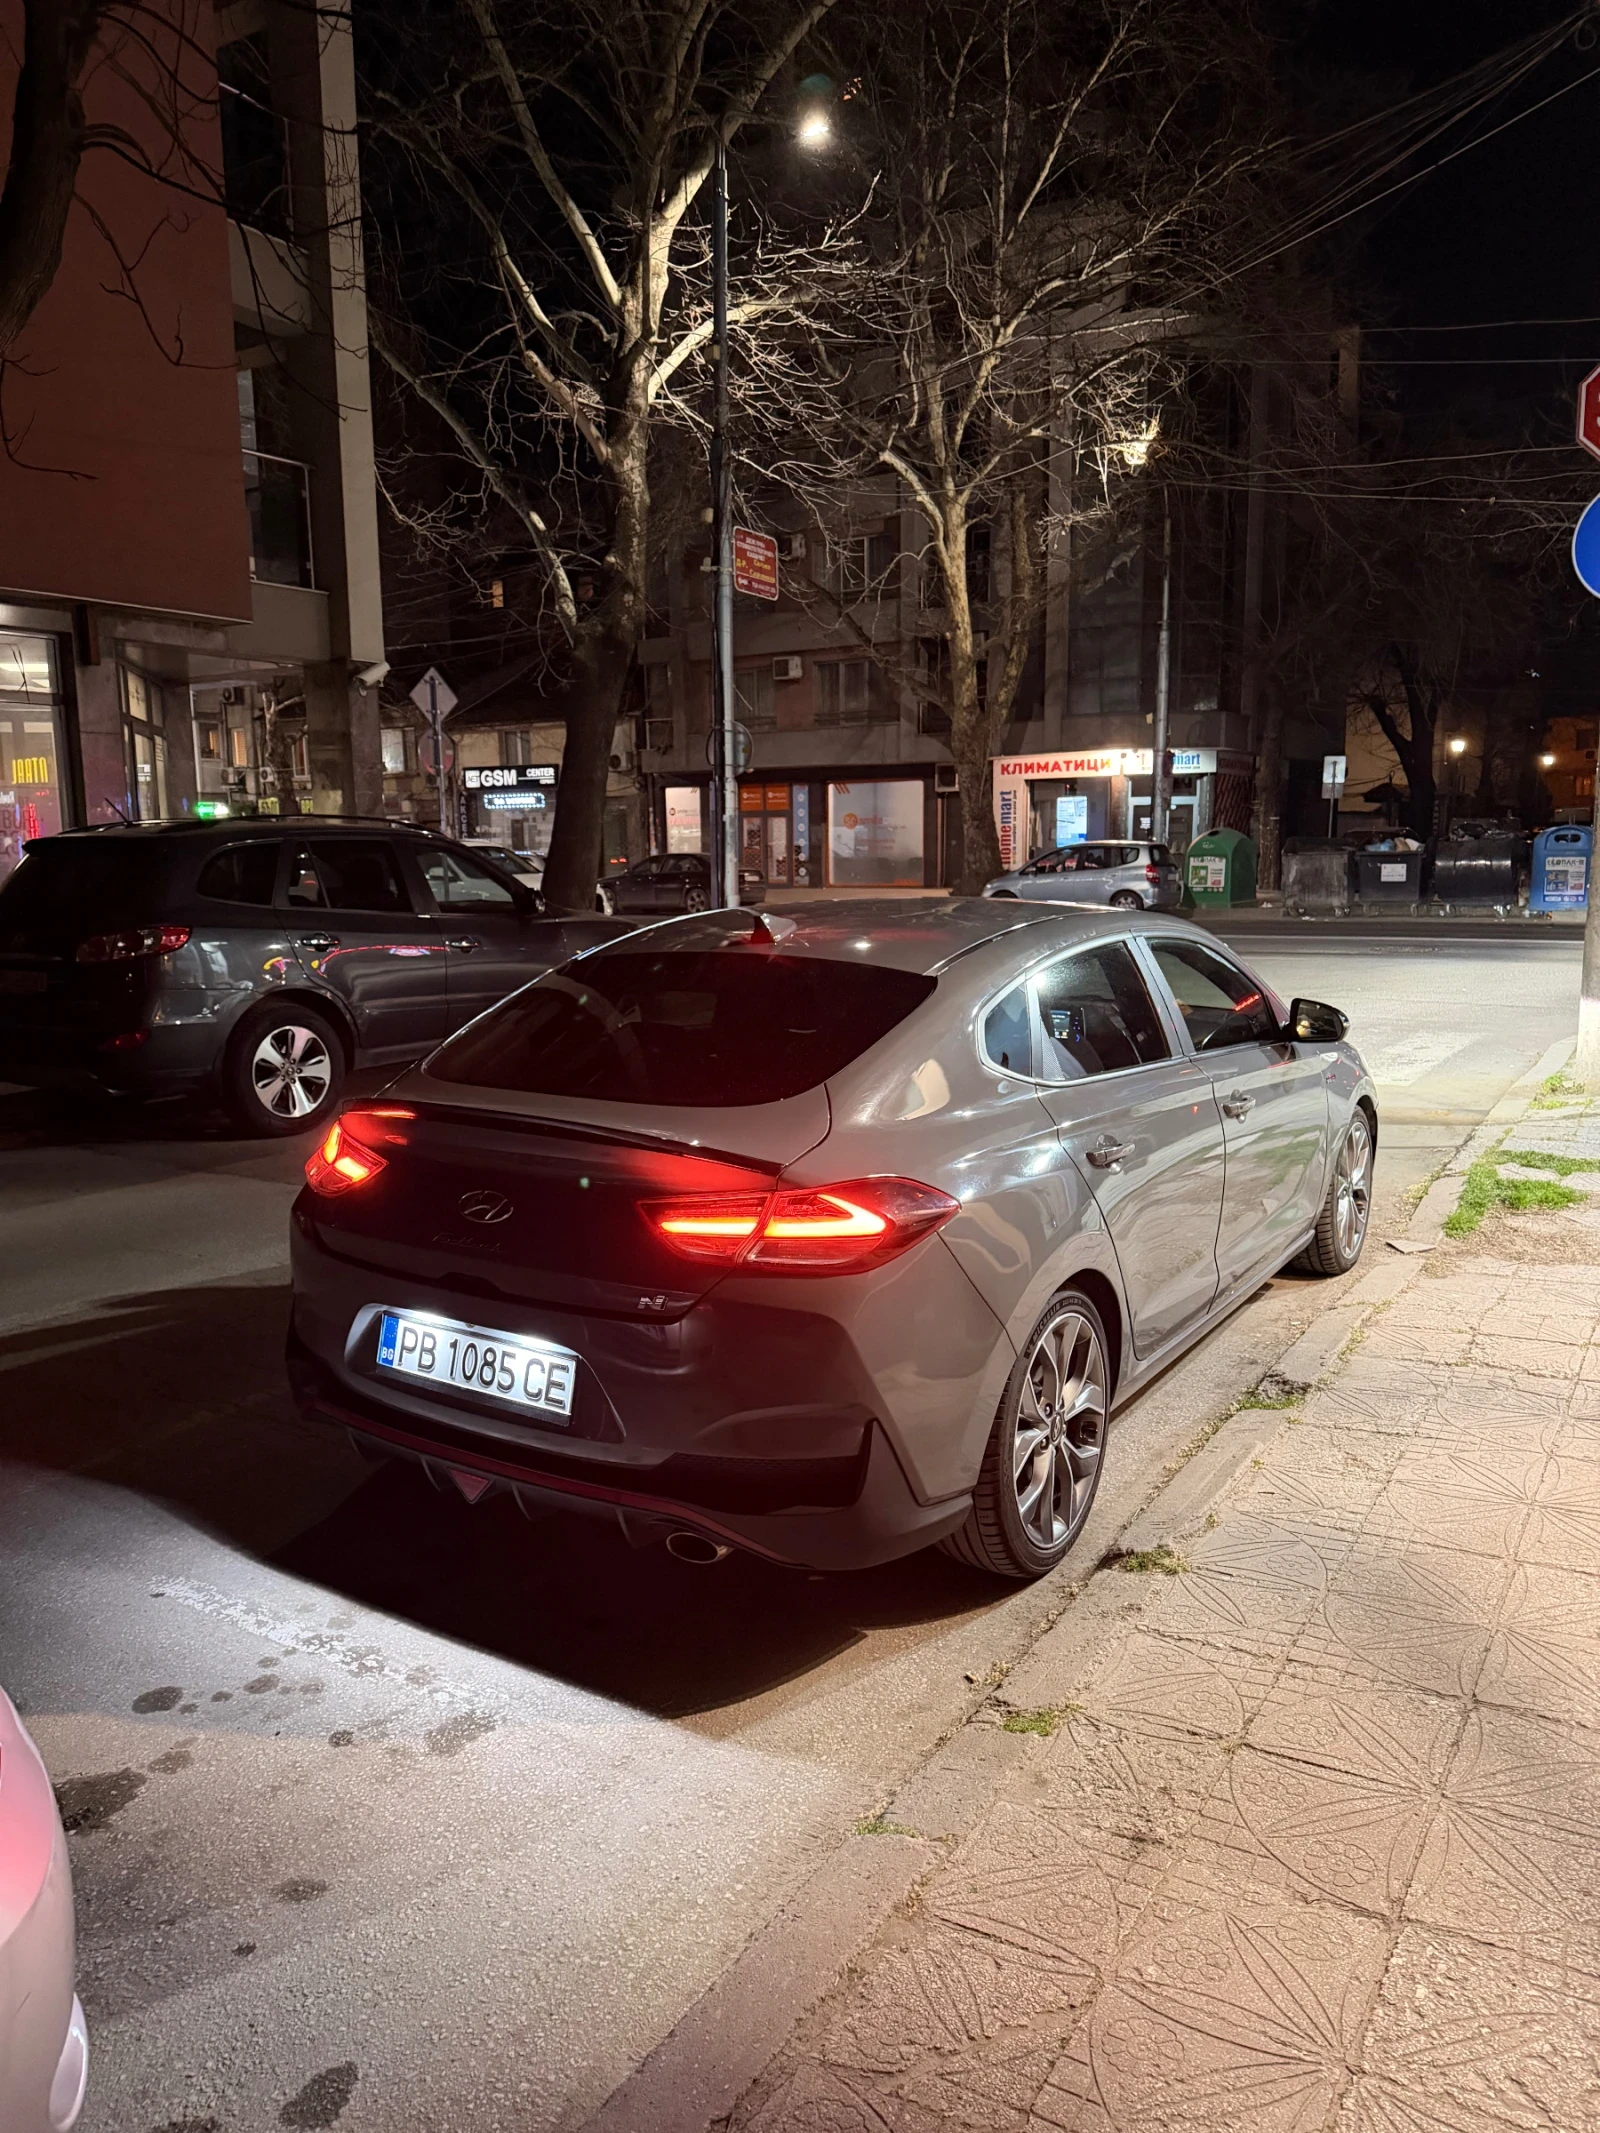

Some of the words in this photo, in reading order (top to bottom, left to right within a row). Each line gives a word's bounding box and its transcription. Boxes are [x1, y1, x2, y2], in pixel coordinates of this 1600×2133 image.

[480, 769, 517, 787] GSM
[526, 767, 555, 777] CENTER
[1000, 758, 1111, 776] КЛИМАТИЦИ
[381, 1347, 394, 1361] BG
[398, 1326, 437, 1373] PB
[449, 1338, 516, 1393] 1085
[523, 1358, 570, 1407] CE
